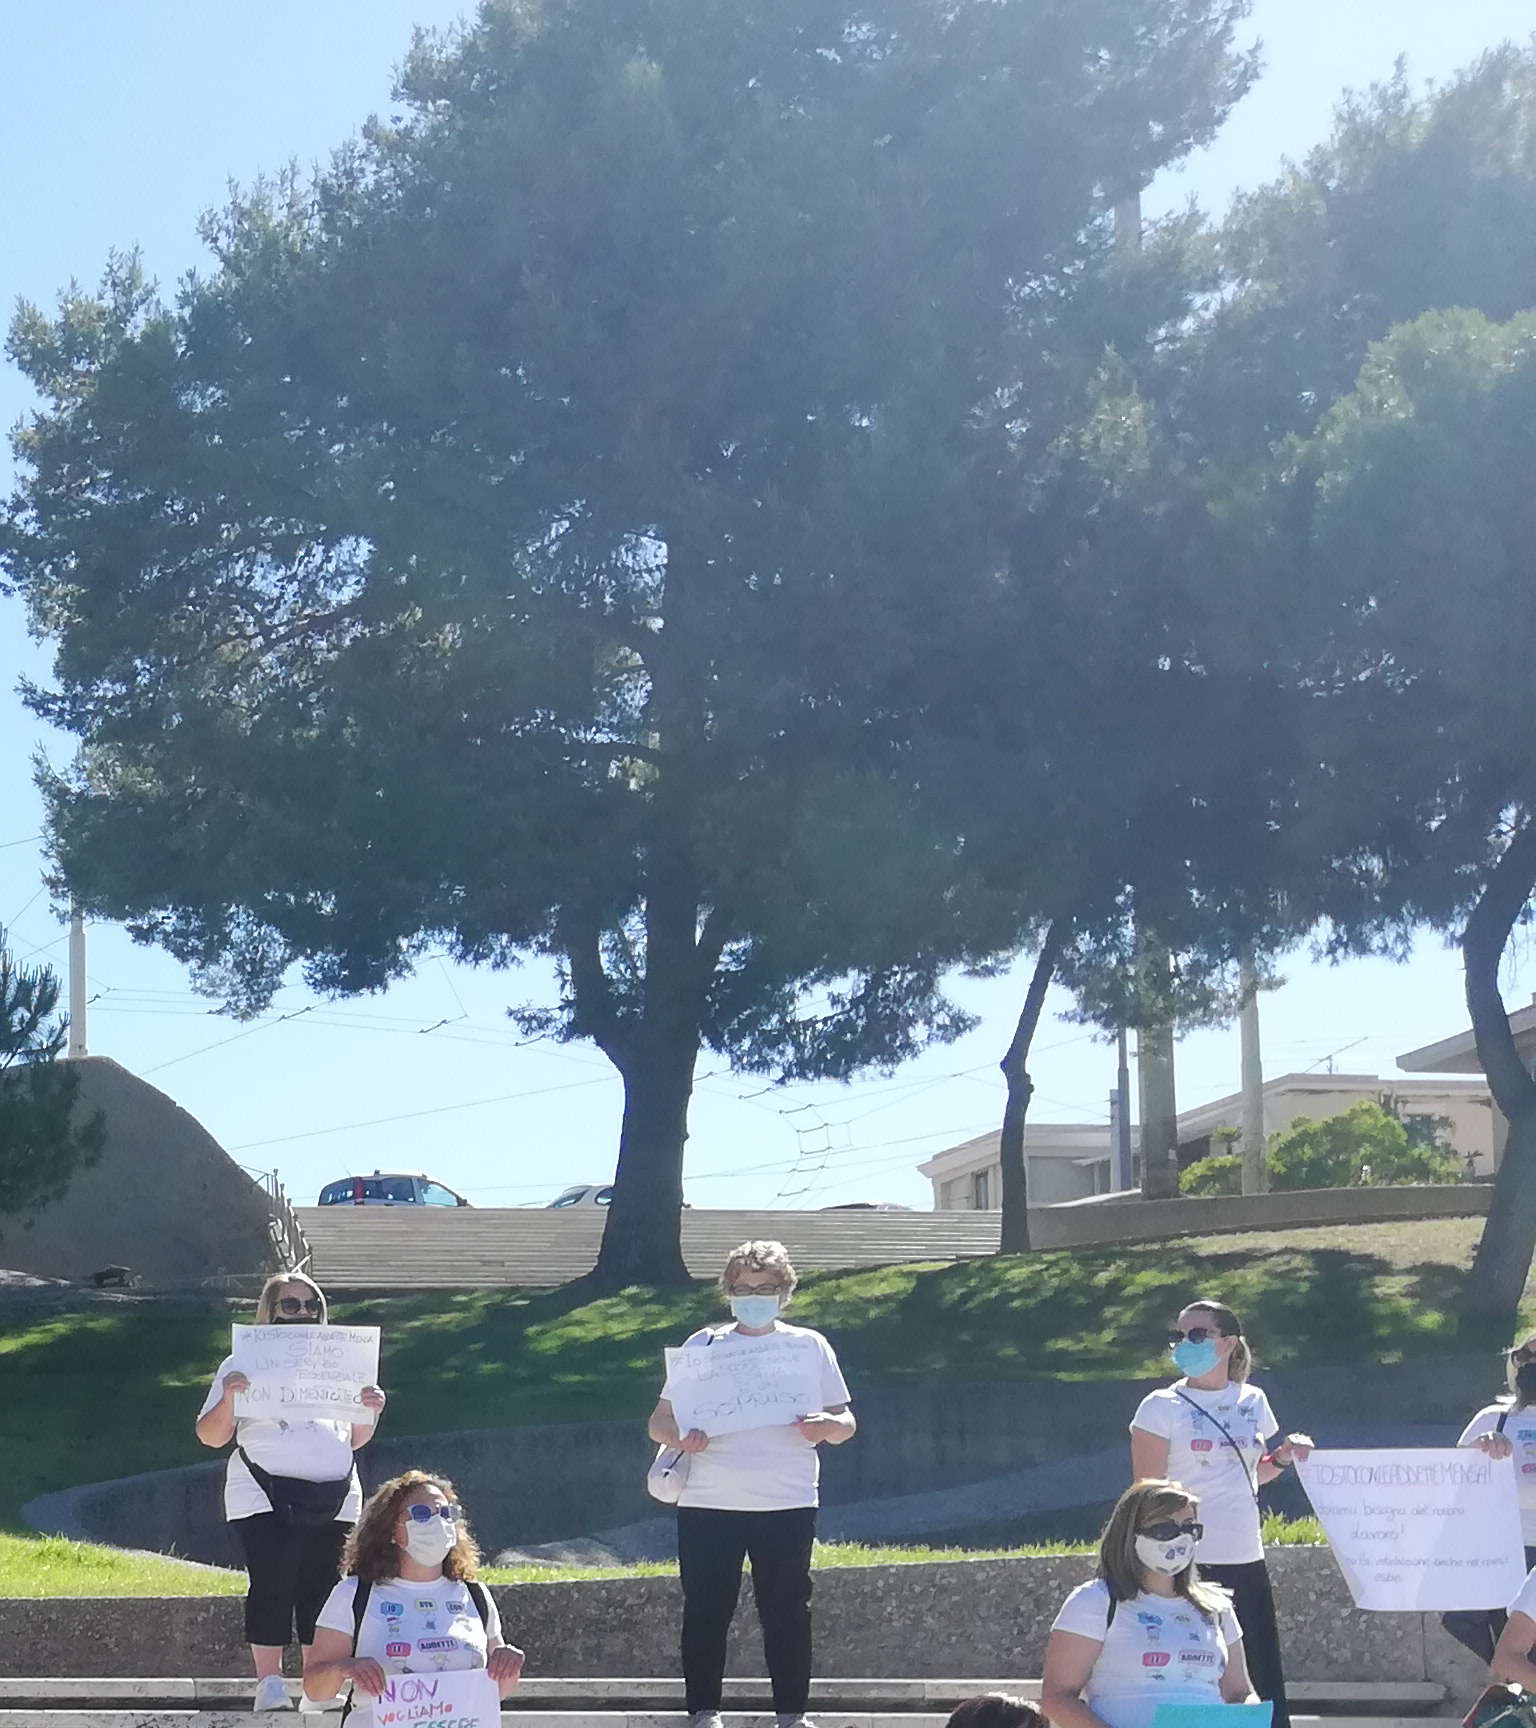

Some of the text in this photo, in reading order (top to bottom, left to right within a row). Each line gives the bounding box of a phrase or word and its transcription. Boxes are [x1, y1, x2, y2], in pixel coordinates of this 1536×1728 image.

[284, 1341, 344, 1358] SIAMO
[377, 1678, 439, 1705] NON
[377, 1701, 454, 1726] VOGLIAMO
